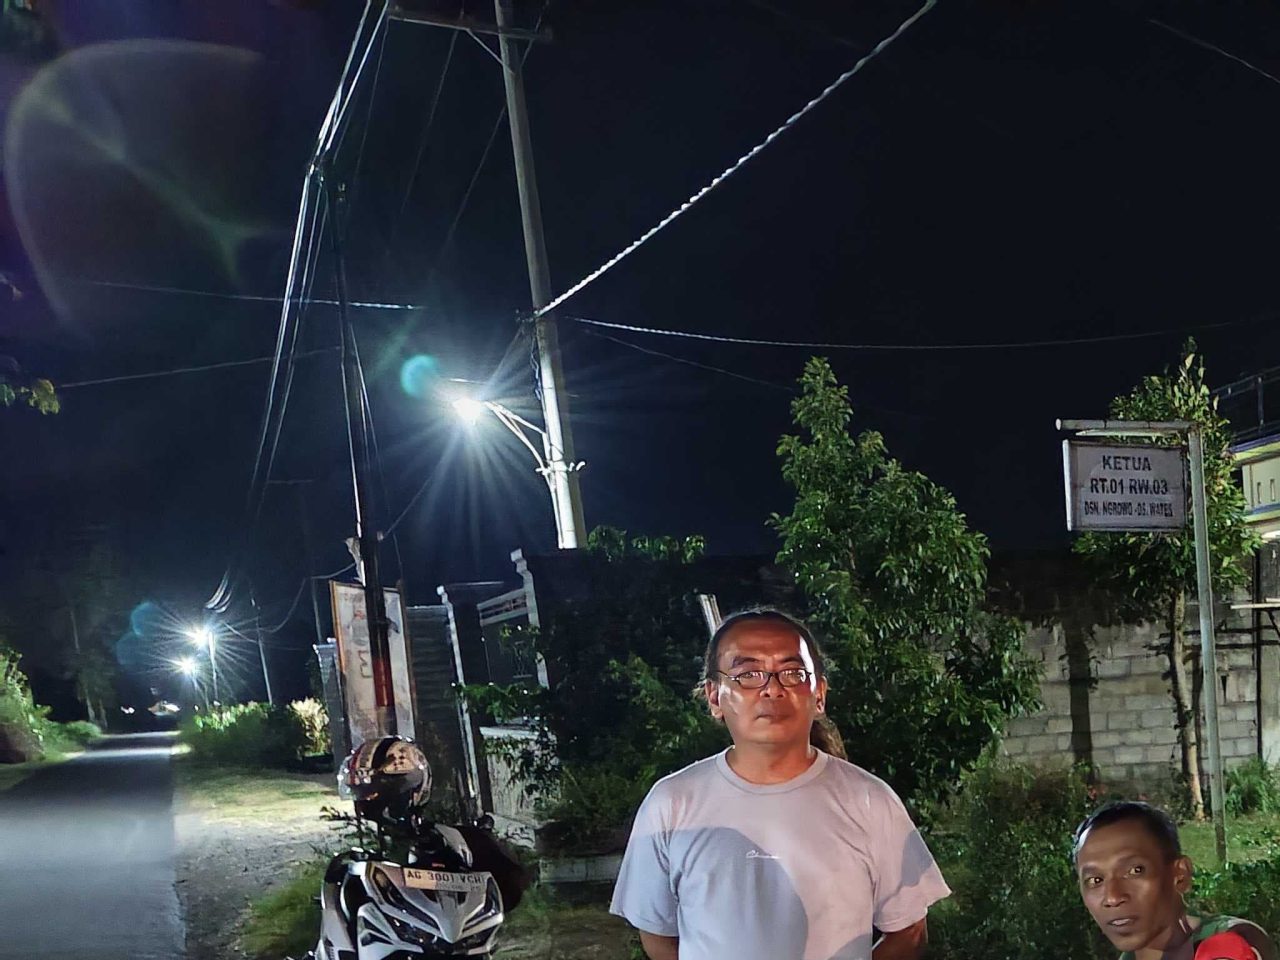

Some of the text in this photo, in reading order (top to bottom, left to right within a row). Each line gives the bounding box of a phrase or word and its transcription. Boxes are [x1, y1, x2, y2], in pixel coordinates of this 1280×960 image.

[1102, 455, 1152, 471] KETUA
[1090, 478, 1168, 495] RT.01 RW.03
[407, 870, 422, 880] AG
